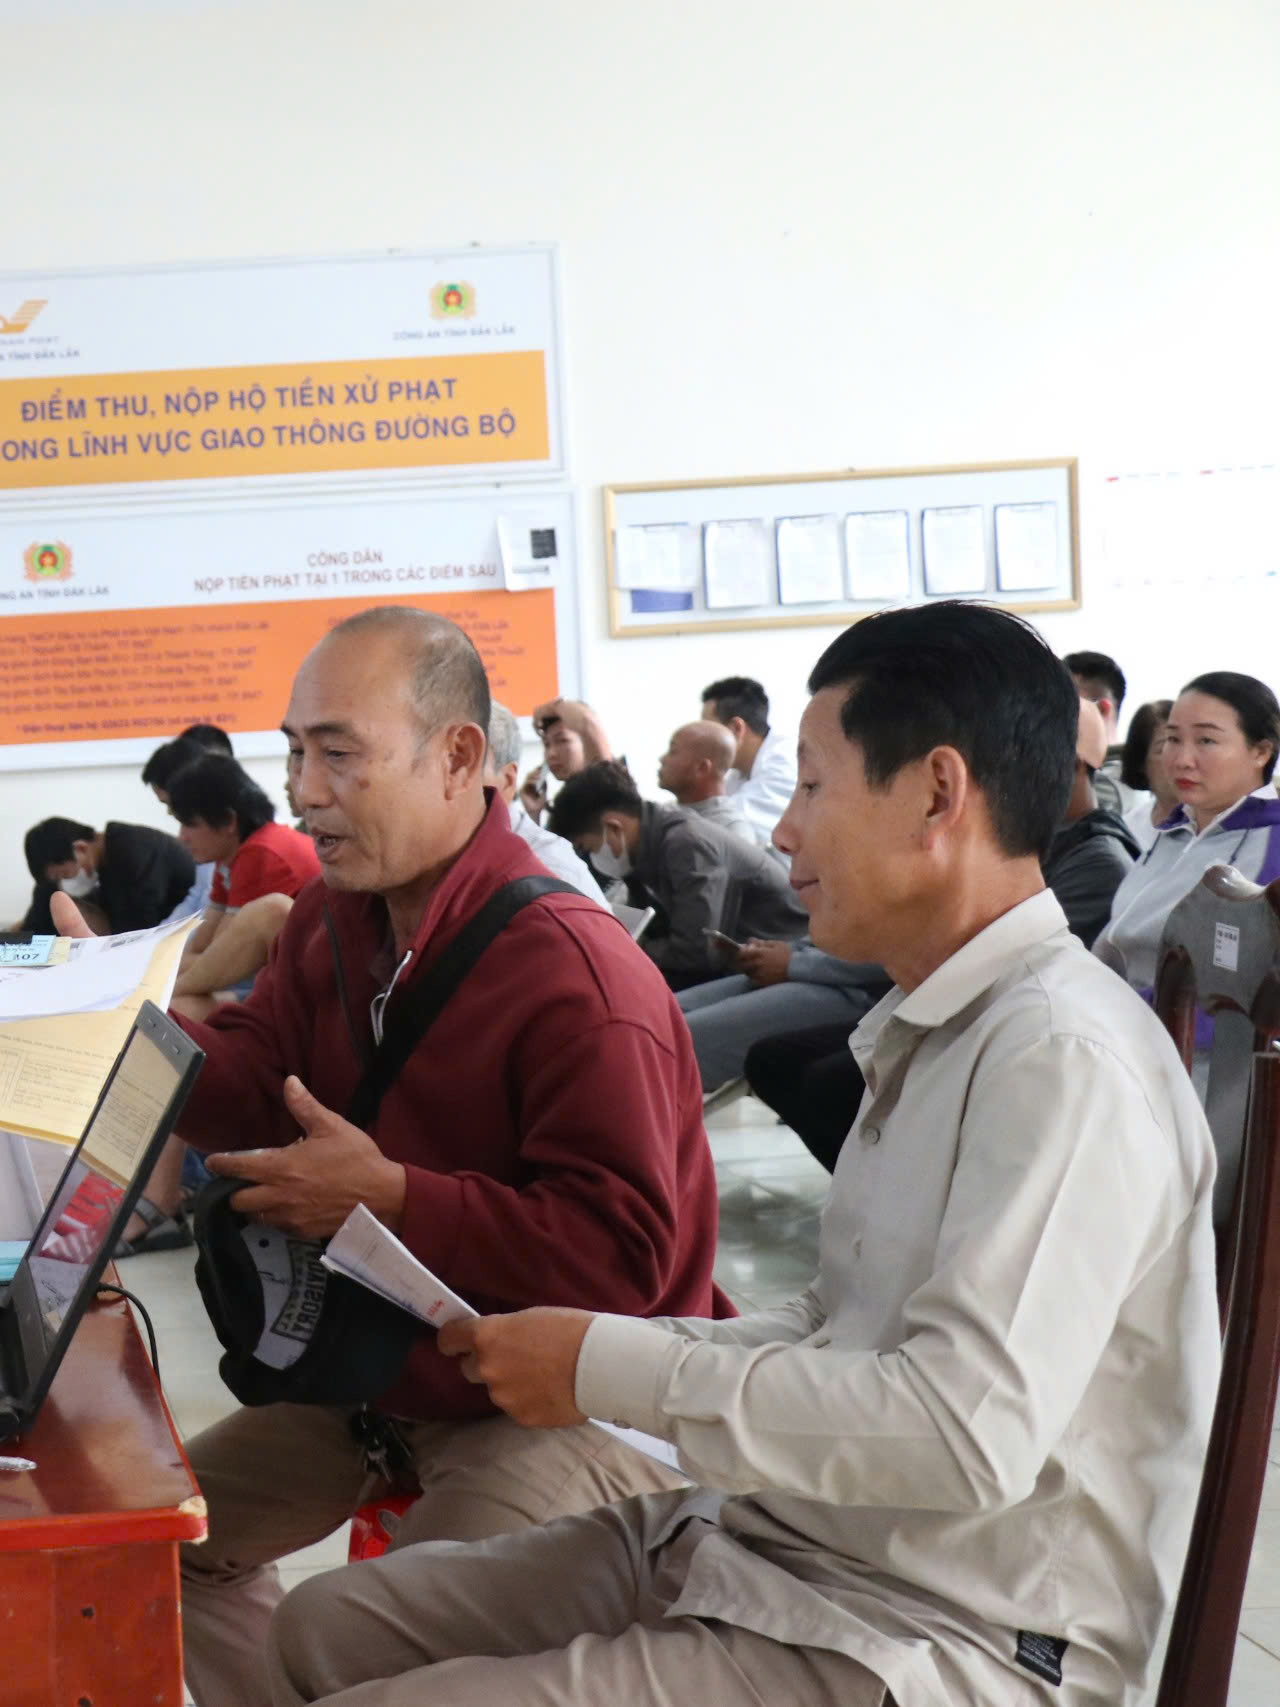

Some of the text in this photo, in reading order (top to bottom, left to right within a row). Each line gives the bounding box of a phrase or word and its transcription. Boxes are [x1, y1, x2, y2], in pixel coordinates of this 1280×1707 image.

[21, 388, 86, 421] ĐIỂM
[96, 394, 156, 418] THU,
[165, 386, 219, 416] NỘP
[229, 382, 266, 413] HỘ
[344, 374, 378, 404] XỬ
[388, 378, 457, 404] PHẠT
[68, 431, 128, 458] LĨNH
[138, 429, 192, 456] VỰC
[200, 427, 265, 450] GIAO
[272, 418, 365, 446] THÔNG
[375, 412, 469, 441] ĐƯỜNG
[479, 408, 516, 438] BỘ
[307, 548, 348, 567] CÔNG
[344, 567, 392, 583] TRONG
[470, 562, 497, 578] SAU
